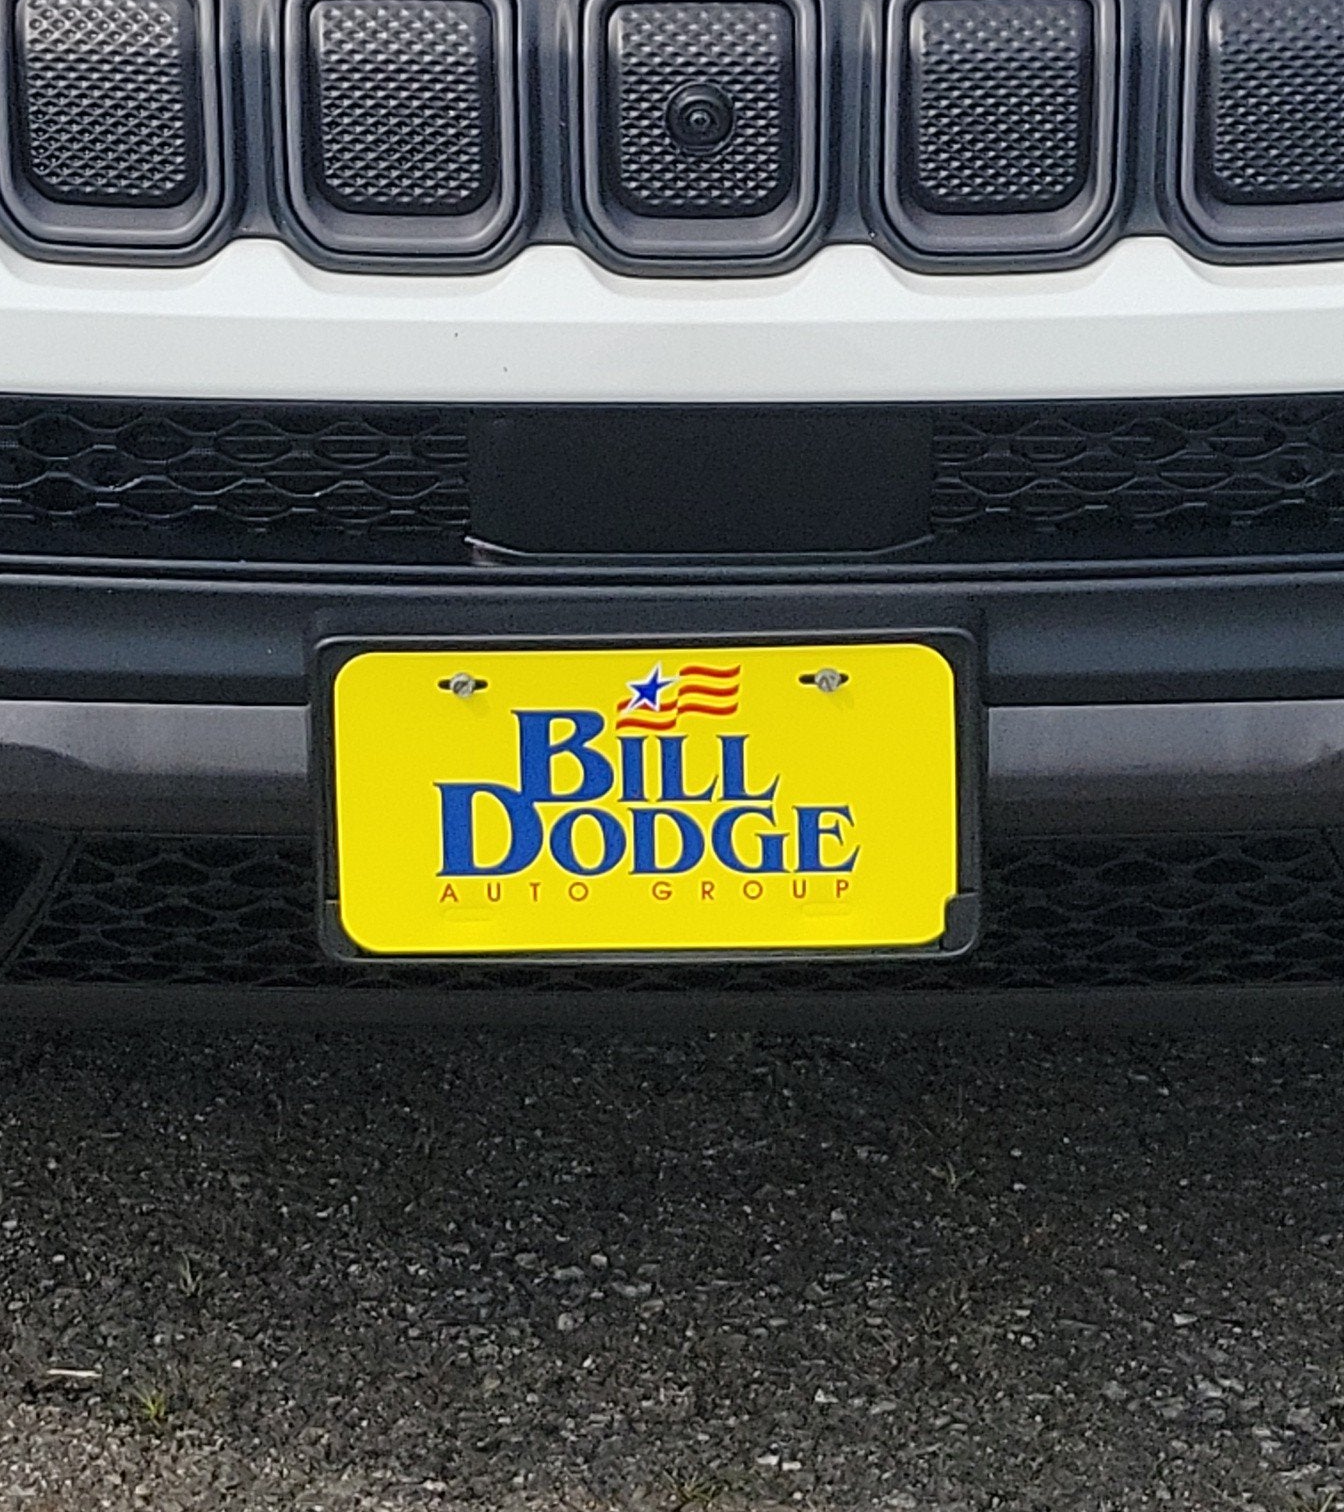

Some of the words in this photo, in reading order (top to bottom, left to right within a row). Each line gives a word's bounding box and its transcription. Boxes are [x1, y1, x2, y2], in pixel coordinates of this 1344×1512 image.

[511, 708, 781, 804] BILL
[433, 781, 861, 878] DODGE
[439, 880, 590, 905] AUTO
[651, 878, 852, 903] GROUP
